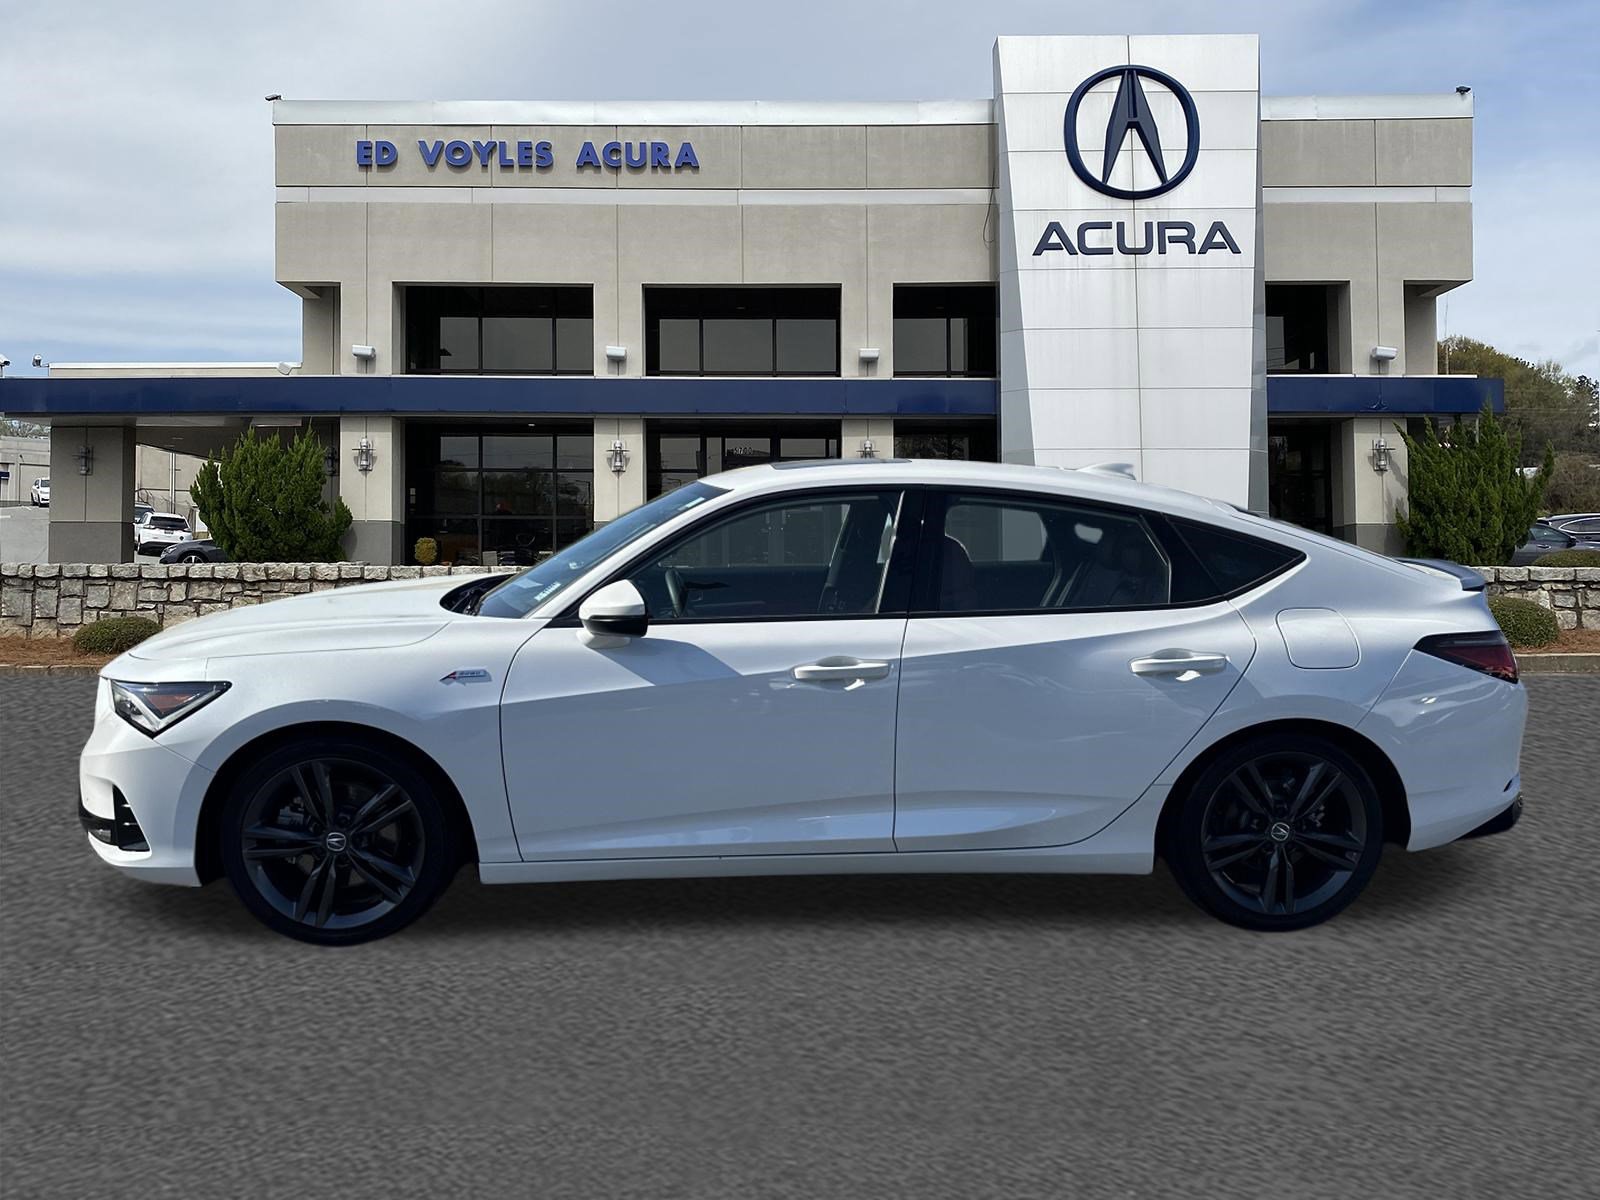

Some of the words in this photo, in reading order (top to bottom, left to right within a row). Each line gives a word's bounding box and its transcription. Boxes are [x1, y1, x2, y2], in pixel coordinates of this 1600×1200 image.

[356, 140, 398, 168] ED
[418, 140, 554, 169] VOYLES
[576, 141, 700, 169] ACURA
[1032, 221, 1242, 256] ACURA
